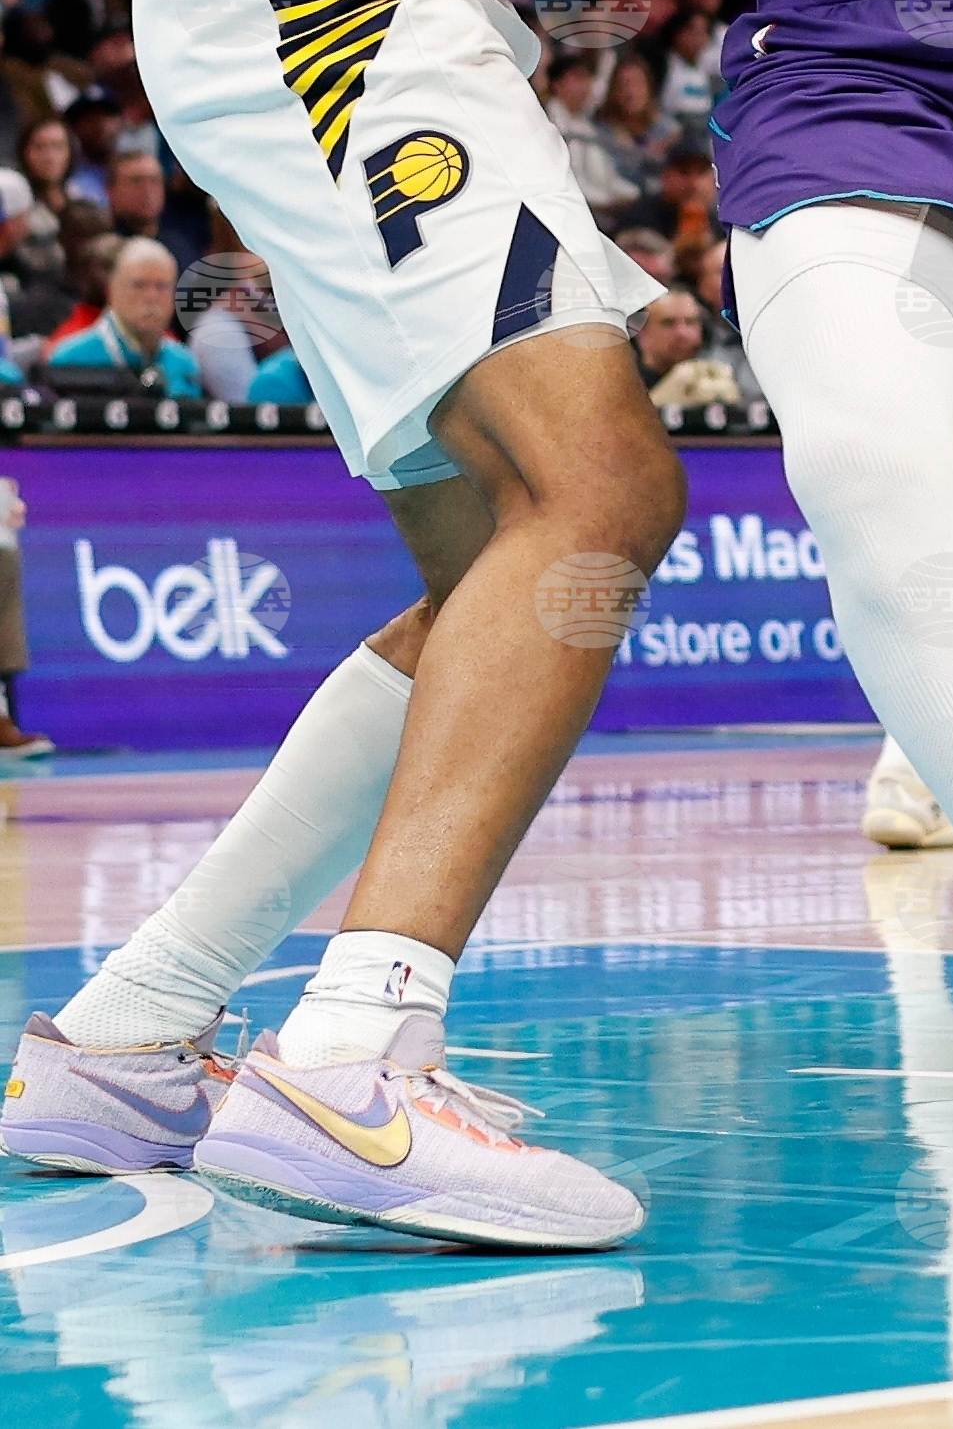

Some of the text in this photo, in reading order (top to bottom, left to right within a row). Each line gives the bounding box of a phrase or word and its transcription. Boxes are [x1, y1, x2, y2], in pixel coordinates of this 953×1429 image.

[74, 536, 288, 663] belk
[638, 615, 752, 668] store
[757, 620, 805, 665] or
